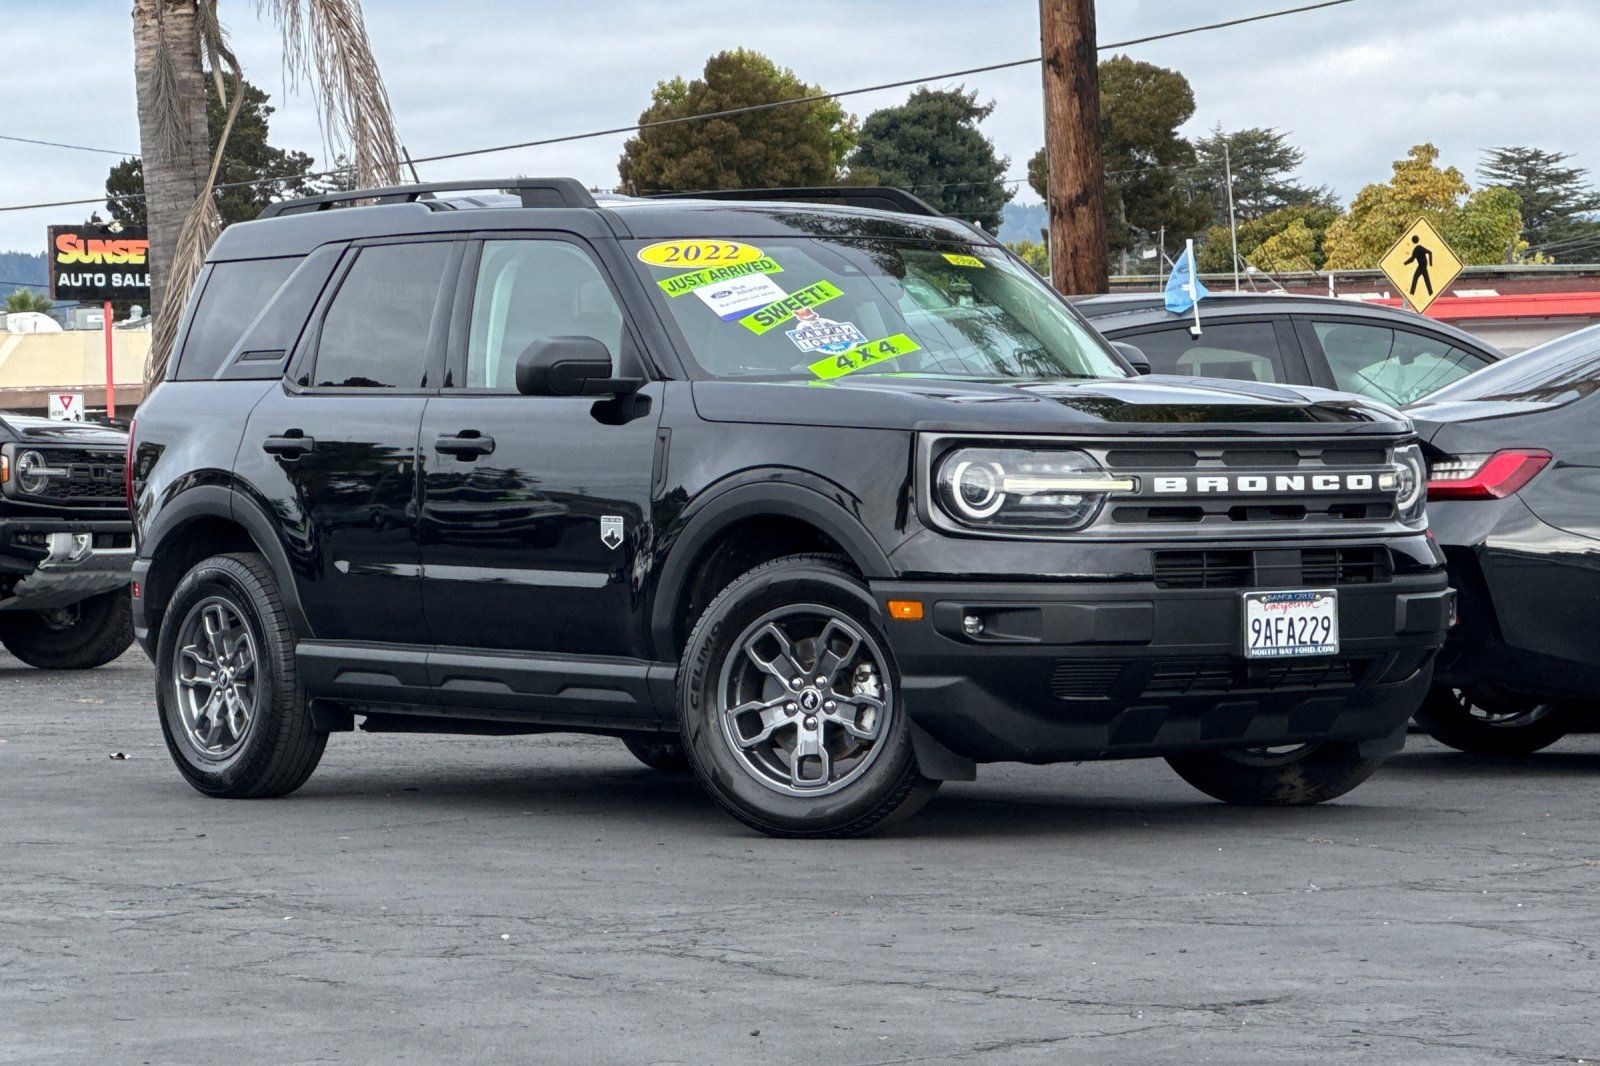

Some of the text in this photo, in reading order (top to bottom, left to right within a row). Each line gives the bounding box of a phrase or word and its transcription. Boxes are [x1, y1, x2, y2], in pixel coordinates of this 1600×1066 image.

[663, 244, 739, 263] 2022
[58, 272, 106, 287] AUTO
[667, 259, 775, 293] JUST ARRIVED
[753, 285, 829, 327] SWEET!
[794, 325, 857, 340] CARFAX
[836, 355, 855, 370] 4
[879, 341, 898, 355] 4
[1154, 475, 1372, 492] BRONCO
[1252, 616, 1331, 647] 9AFA229
[1251, 646, 1334, 656] NORTH BAY FORD.COM
[691, 621, 720, 709] CELIMO
